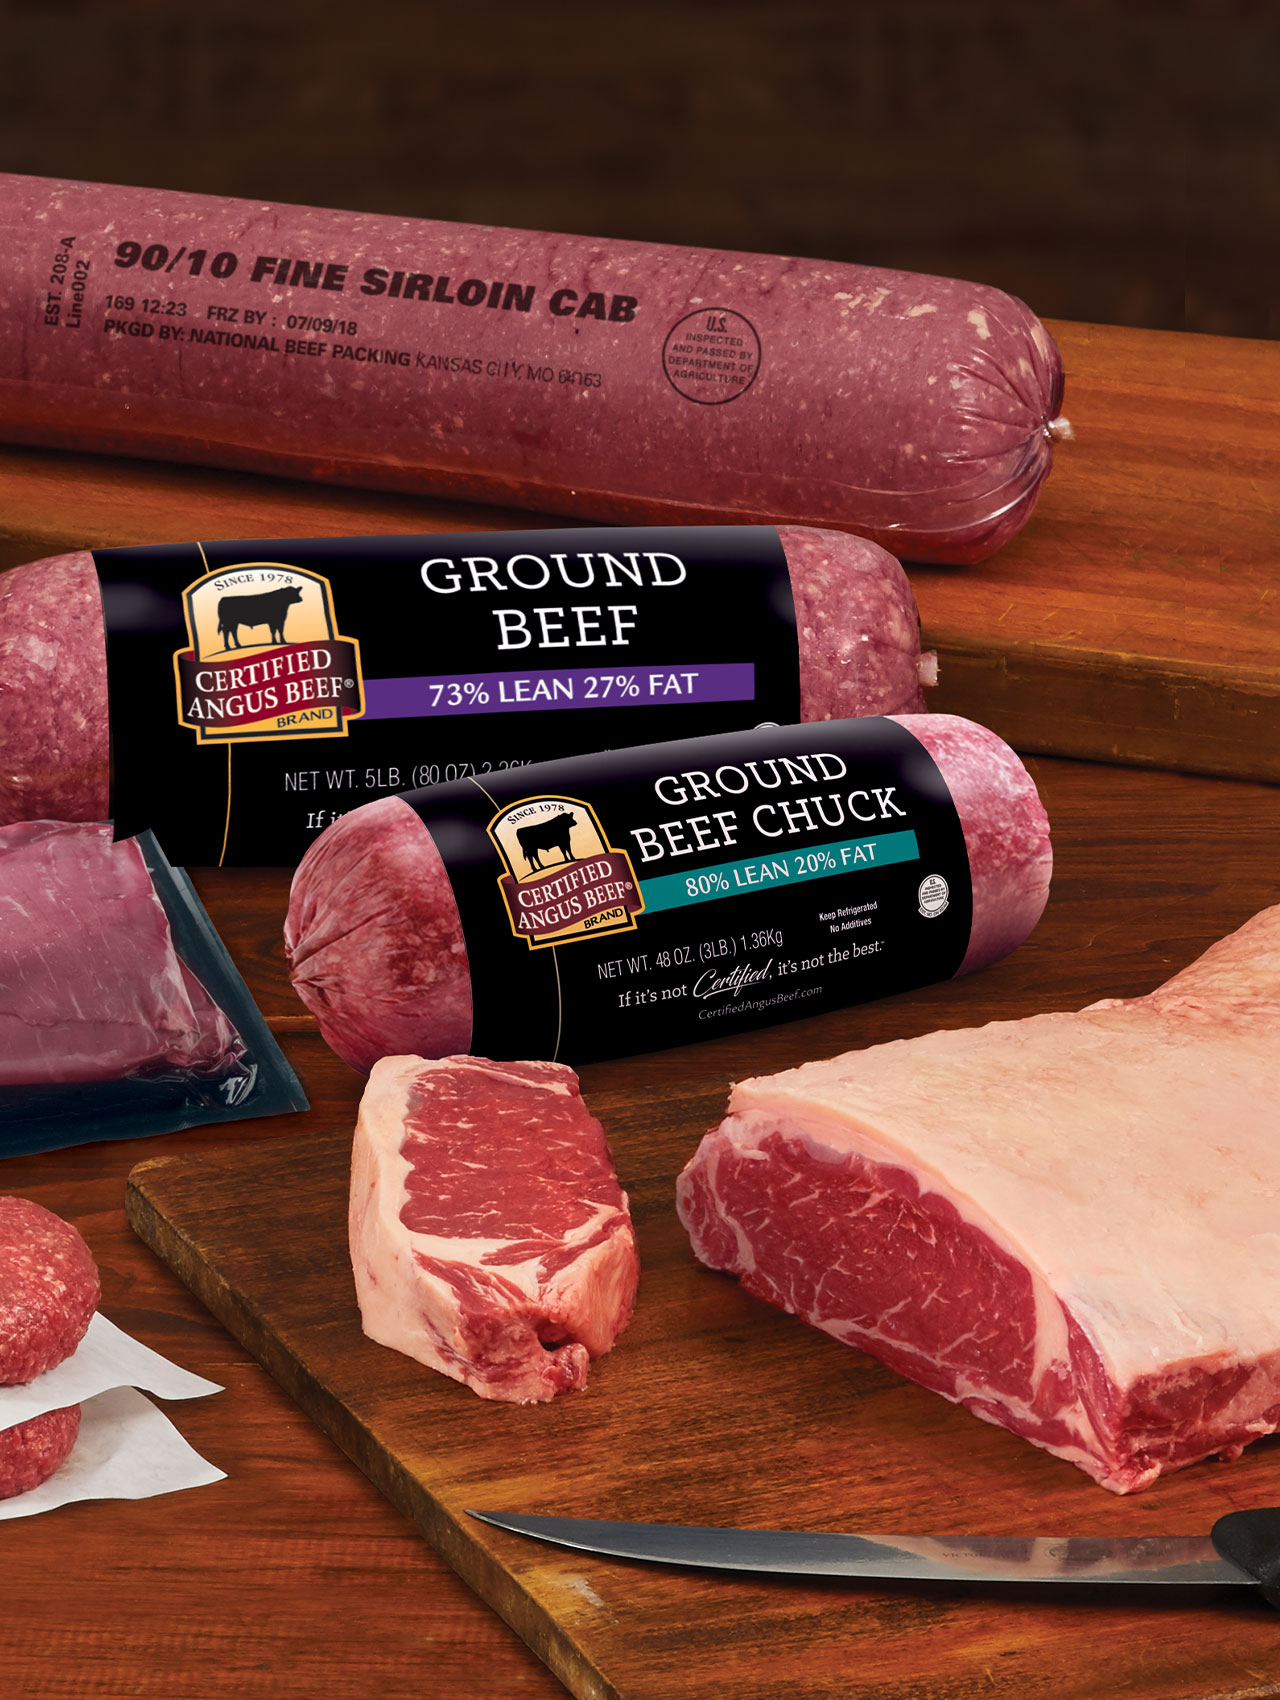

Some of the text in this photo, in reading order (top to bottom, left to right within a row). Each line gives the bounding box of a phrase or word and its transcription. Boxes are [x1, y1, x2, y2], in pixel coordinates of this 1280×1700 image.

[44, 236, 76, 326] EST. 208-A
[66, 259, 90, 328] Line002
[114, 241, 639, 322] 90/10 FINE SIRLOIN CAB
[105, 295, 358, 336] 169 12:23 FRZ BY 07/09/18
[104, 319, 411, 367] PKGD BY: NATIONAL BEEF PACKING
[420, 553, 687, 595] GROUND
[493, 606, 638, 650] BEEF
[195, 649, 331, 693] CERTIFIED
[429, 673, 698, 707] 73% LEAN 27% FAT
[187, 687, 278, 719] ANGUS
[277, 709, 333, 728] BRAND
[654, 753, 847, 806] GROUND
[630, 787, 907, 862] BEEF CHUCK
[518, 860, 612, 907] CERTIFIED
[685, 843, 877, 898] 80% LEAN 20% FAT
[518, 897, 582, 929] ANGUS
[584, 908, 623, 929] BRAND
[819, 901, 878, 922] Keep Refrigerated
[830, 917, 872, 934] No Additives
[598, 929, 783, 980] NET WT. 48 OZ. (3LB.) 1.36Kg
[699, 986, 823, 1020] CertifiedAngusBeef.com
